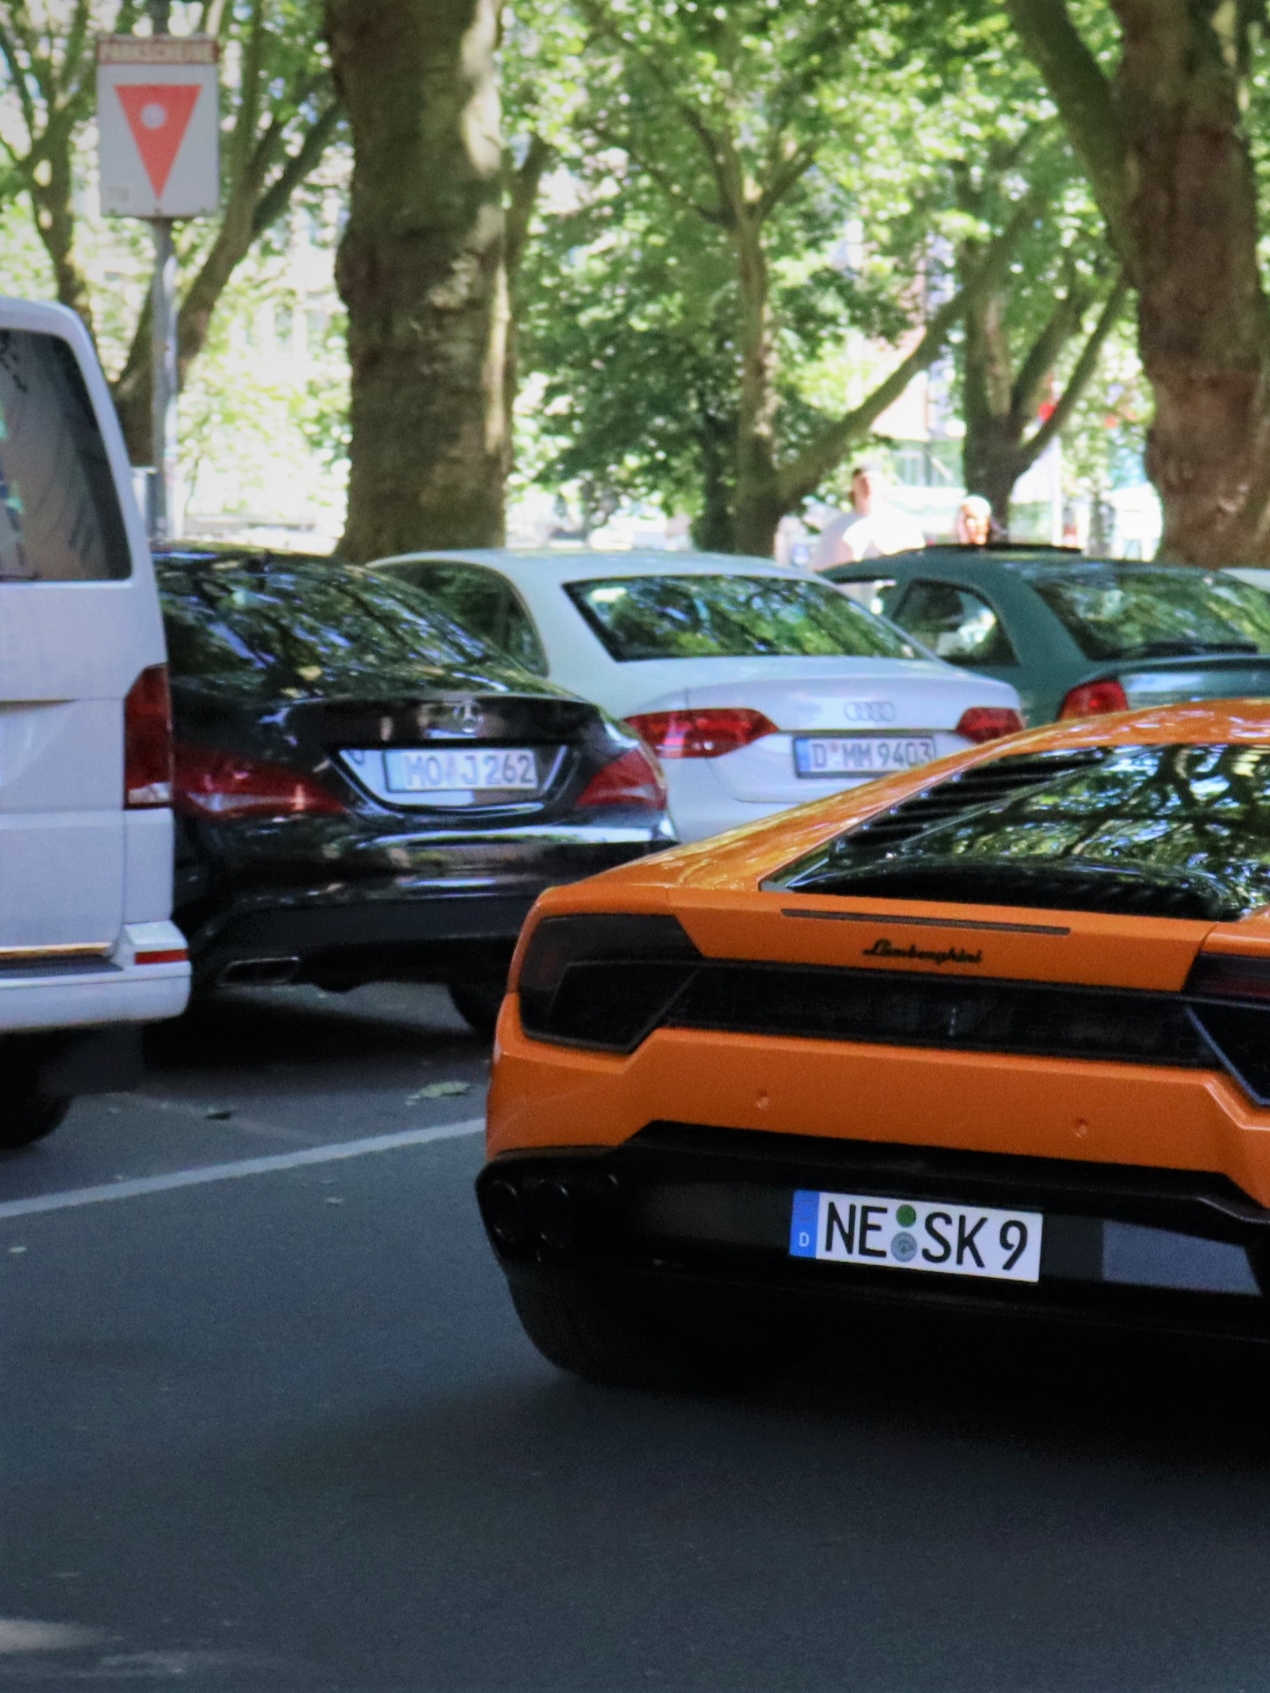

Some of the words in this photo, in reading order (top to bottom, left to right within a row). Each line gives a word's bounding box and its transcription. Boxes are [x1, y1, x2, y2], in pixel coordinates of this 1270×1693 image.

[842, 742, 873, 768] MM
[877, 741, 933, 767] 9403
[404, 754, 444, 787] MO
[460, 754, 478, 786] J
[483, 753, 535, 785] 262
[861, 938, 984, 965] Lamborghini
[798, 1231, 811, 1248] D
[824, 1201, 889, 1259] NE
[921, 1211, 989, 1269] SK
[998, 1219, 1029, 1271] 9
